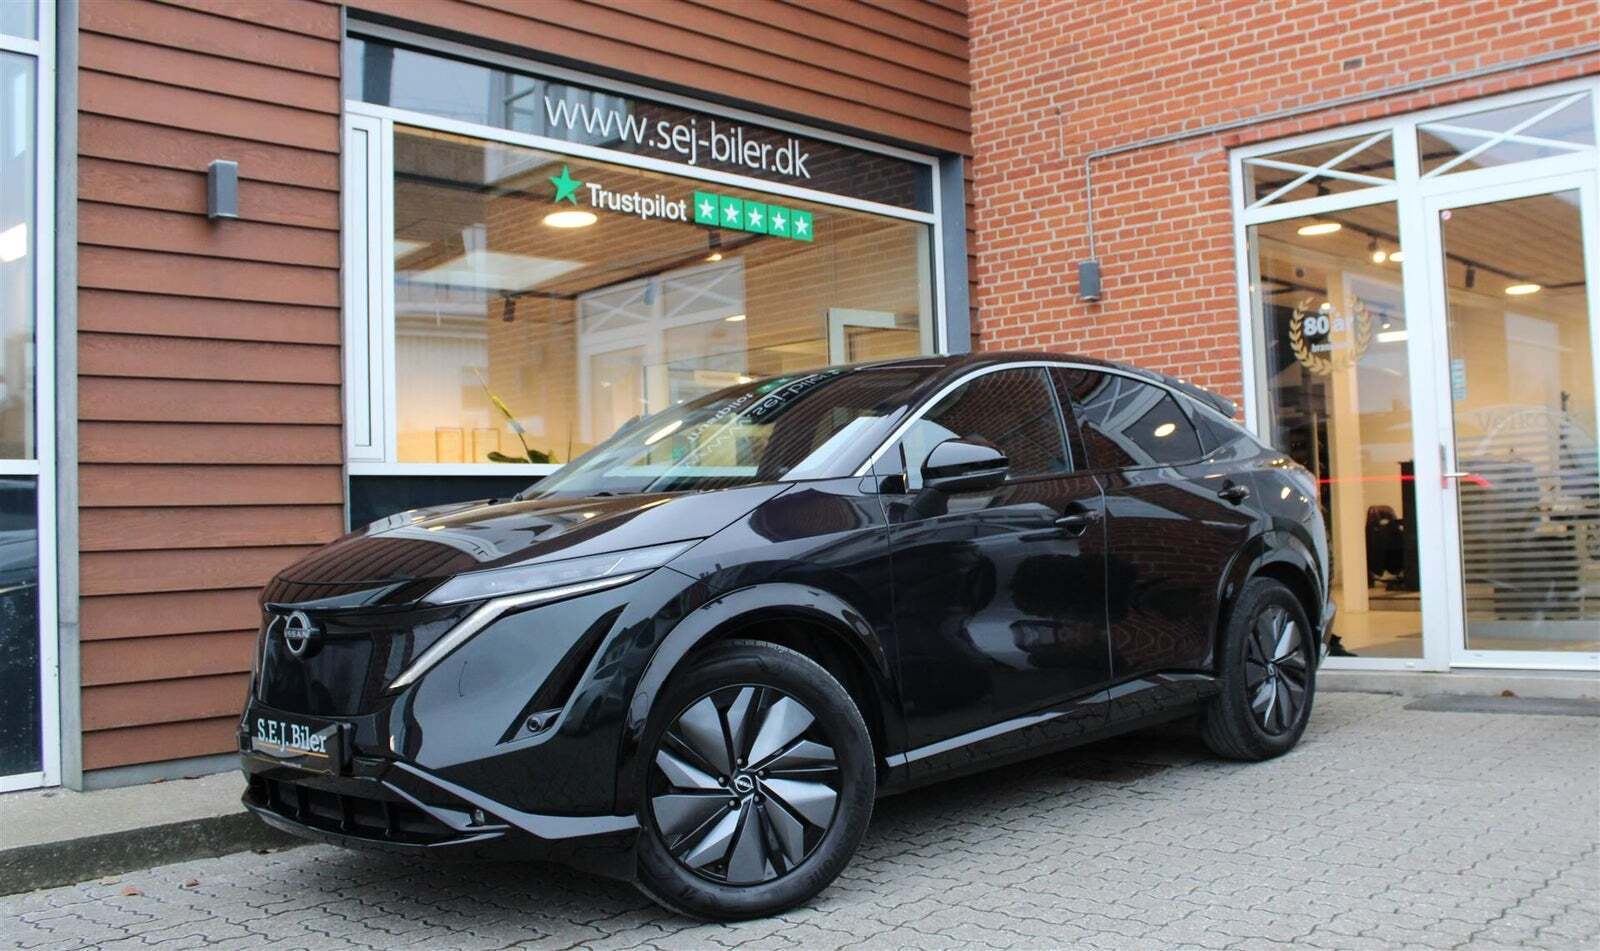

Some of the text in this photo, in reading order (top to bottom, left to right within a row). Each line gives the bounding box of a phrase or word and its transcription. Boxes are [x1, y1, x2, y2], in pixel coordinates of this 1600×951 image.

[544, 95, 811, 179] www.sej-biler.dk
[585, 182, 688, 221] Trustpilot
[1303, 315, 1328, 337] 80
[257, 718, 327, 752] S.E.J. Biler
